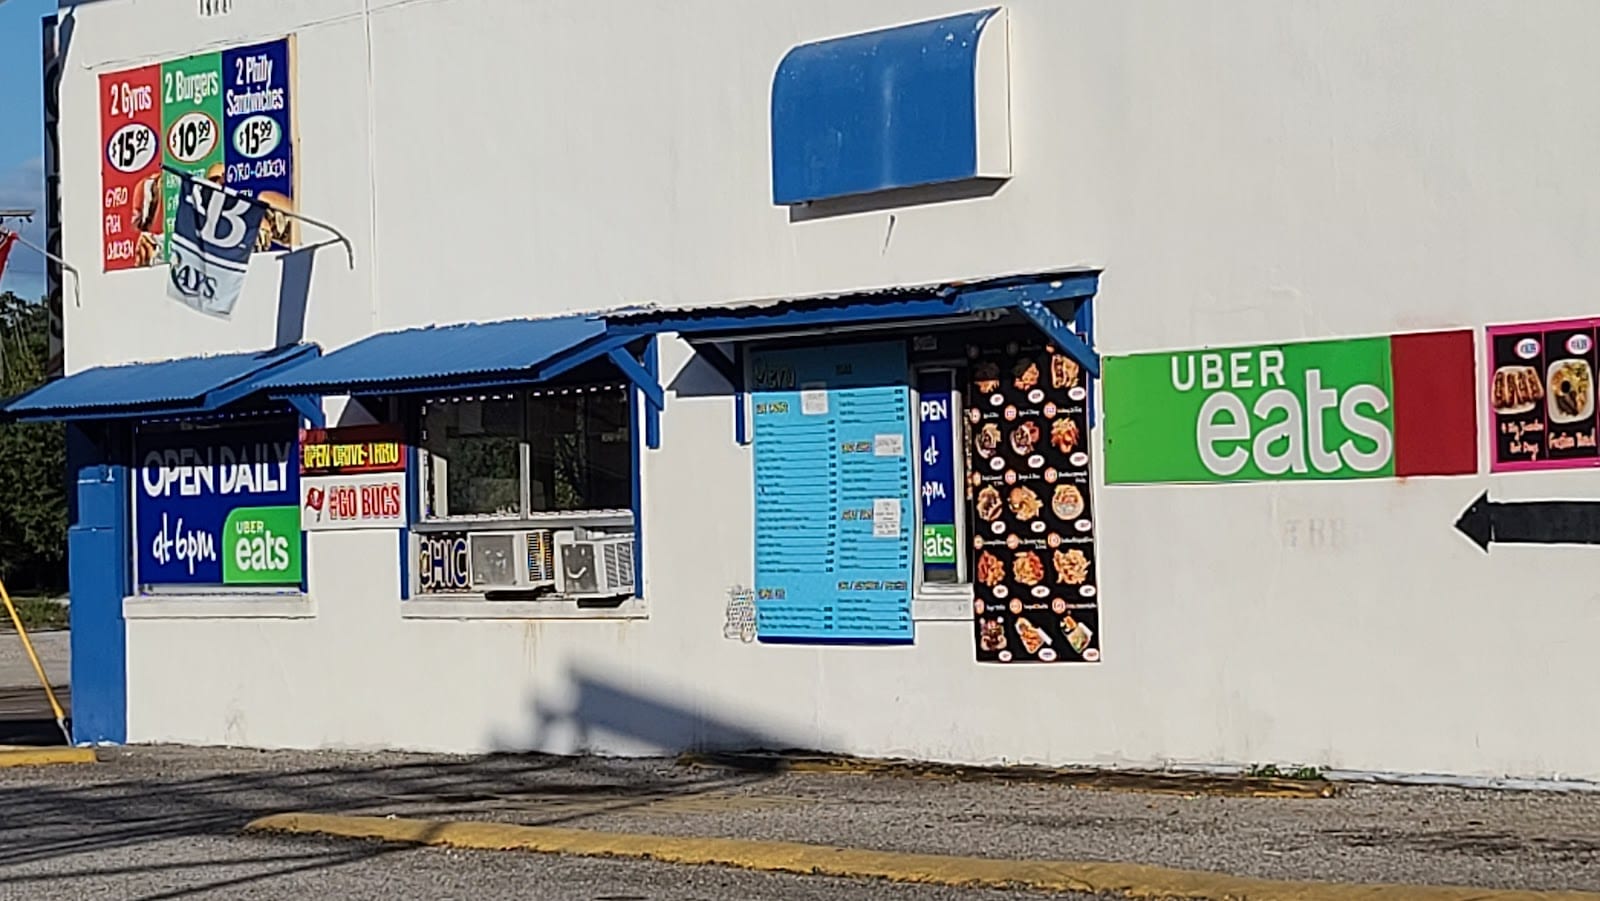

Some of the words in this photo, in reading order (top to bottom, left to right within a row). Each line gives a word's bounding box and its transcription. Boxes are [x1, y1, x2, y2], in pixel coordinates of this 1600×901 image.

[165, 75, 174, 104] 2
[175, 70, 219, 105] Burgers
[236, 57, 244, 85] 2
[246, 54, 273, 88] Philly
[110, 83, 119, 115] 2
[121, 82, 152, 118] Gyros
[226, 85, 284, 116] Sandwiches
[1170, 349, 1286, 391] UBER
[921, 399, 948, 422] PEN
[1196, 369, 1393, 476] eats
[142, 445, 215, 498] OPEN
[219, 441, 292, 495] DAILY
[303, 444, 331, 468] OPEN
[361, 484, 401, 519] BUCS
[153, 512, 174, 565] at
[175, 517, 217, 575] 6pm
[235, 520, 264, 533] UBER
[235, 530, 289, 571] eats
[924, 533, 954, 557] ats
